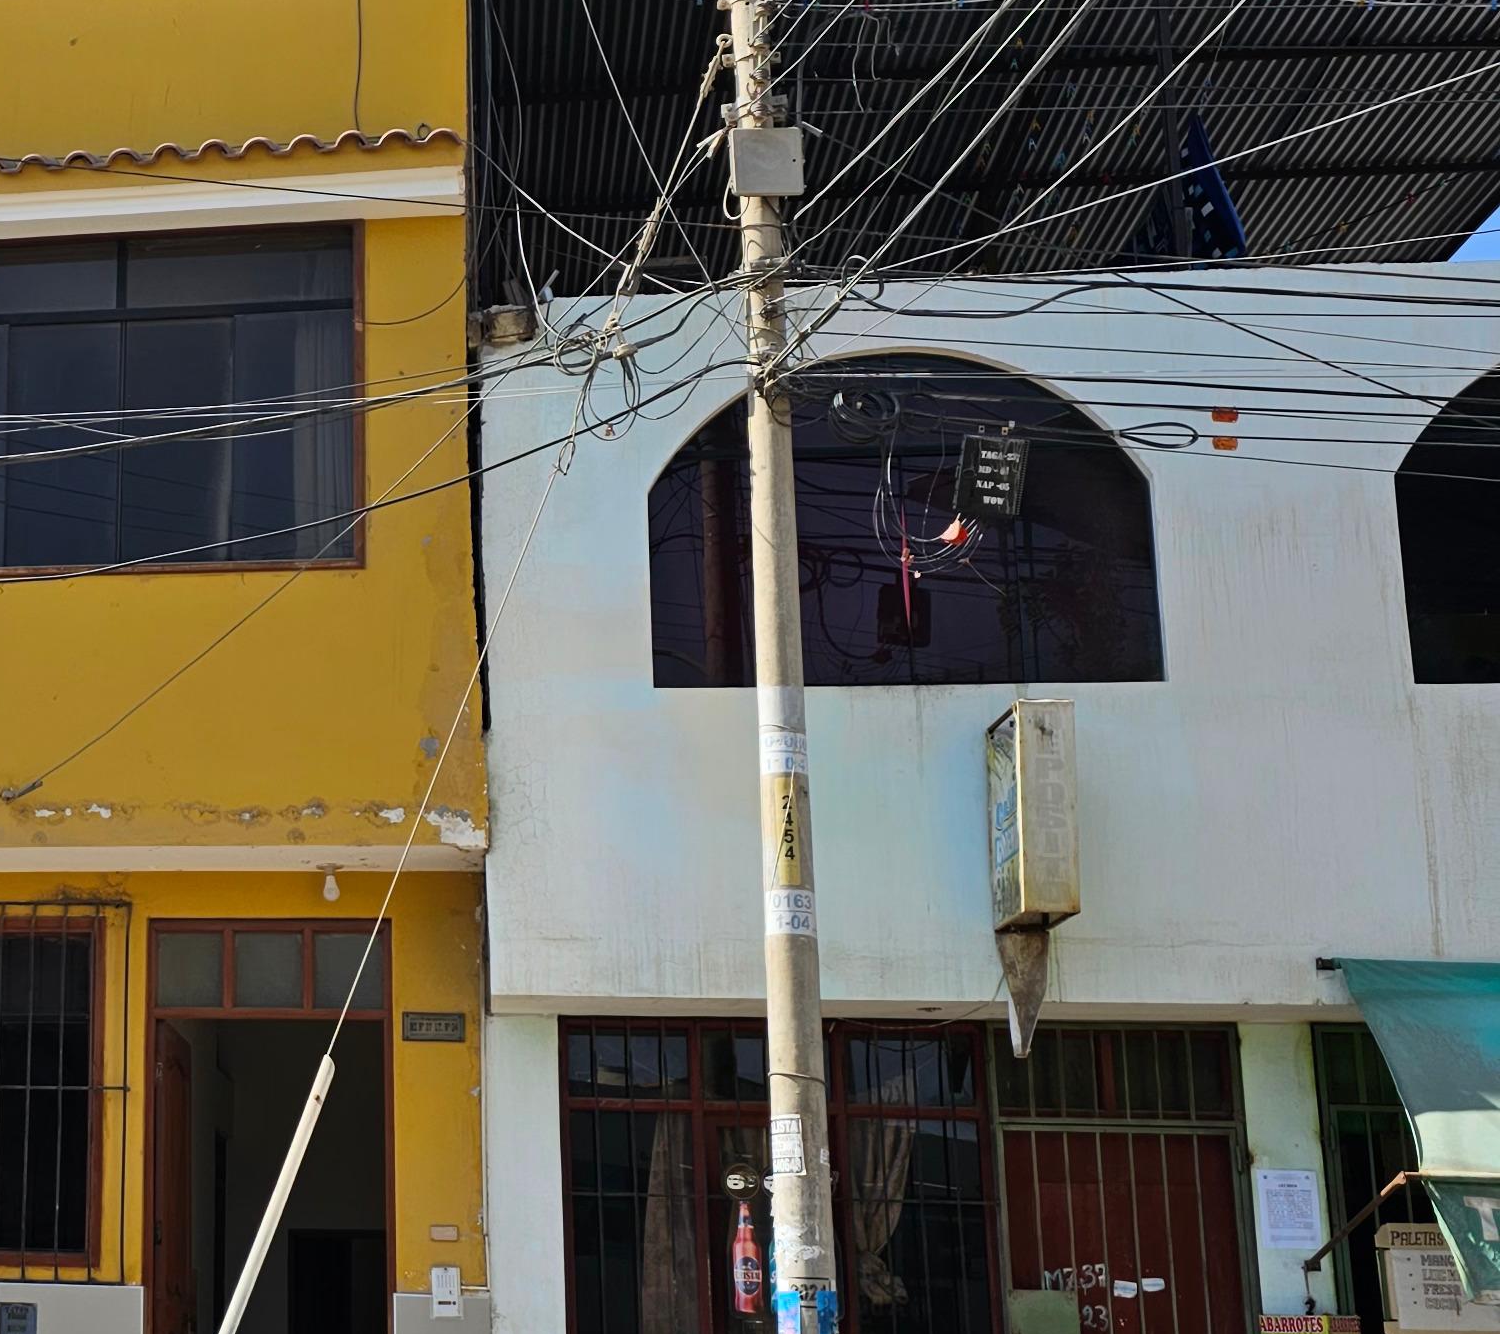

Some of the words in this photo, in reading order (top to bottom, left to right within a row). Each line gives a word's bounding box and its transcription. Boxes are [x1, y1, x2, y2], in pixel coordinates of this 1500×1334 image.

[983, 496, 1005, 505] WOW
[781, 795, 796, 860] 2454
[773, 893, 812, 910] 0163
[776, 914, 810, 931] 1-04
[1391, 1231, 1444, 1247] PALETAS
[1420, 1254, 1455, 1267] MANG
[1260, 1317, 1323, 1332] ABARROTES
